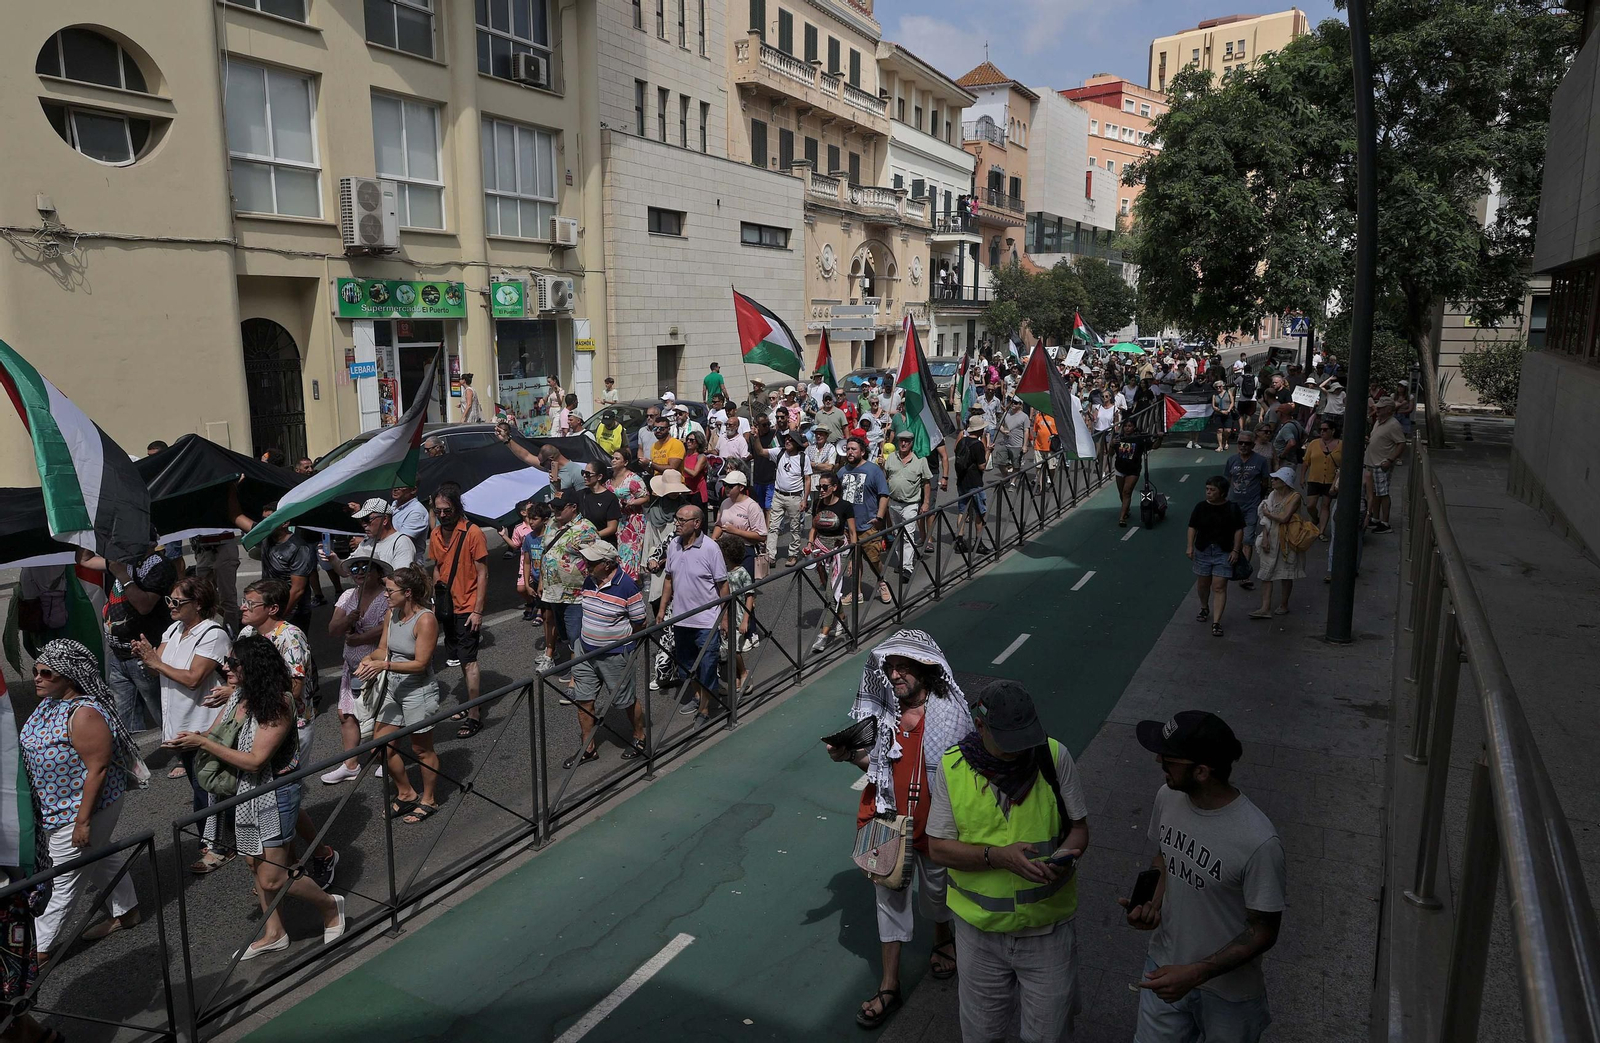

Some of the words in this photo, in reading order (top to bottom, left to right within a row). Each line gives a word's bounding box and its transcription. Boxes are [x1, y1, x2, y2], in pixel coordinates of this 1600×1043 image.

[361, 304, 421, 313] Supermercado
[350, 365, 376, 375] LEBARA
[1159, 824, 1223, 882] CANADA
[1162, 851, 1205, 891] AMP
